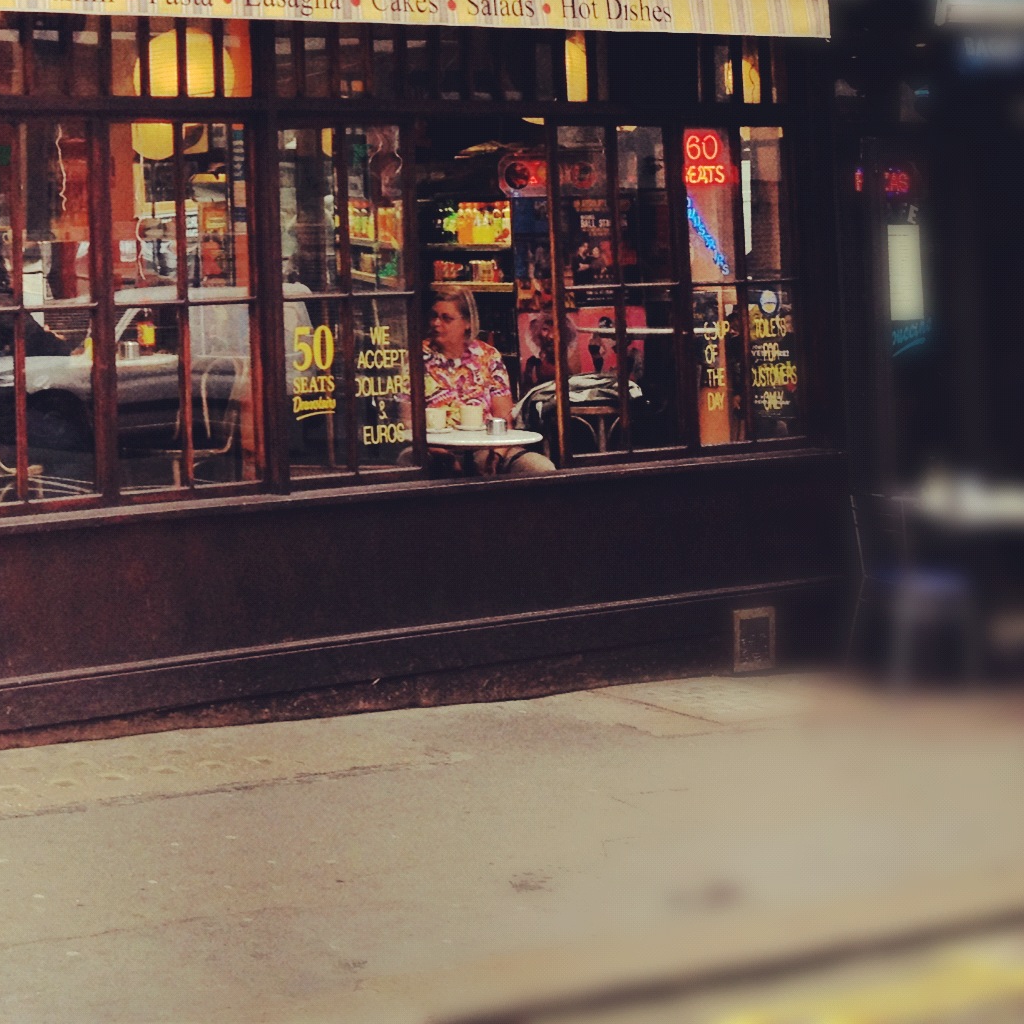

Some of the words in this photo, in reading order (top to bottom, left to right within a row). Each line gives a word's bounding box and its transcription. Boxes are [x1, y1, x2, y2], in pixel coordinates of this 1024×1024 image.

[686, 134, 718, 160] 60
[370, 325, 391, 346] WE
[292, 325, 335, 372] 50
[704, 343, 719, 365] OF
[357, 349, 407, 370] ACCEPT
[293, 376, 336, 394] SEATS
[706, 368, 726, 387] THE
[378, 401, 388, 420] &
[707, 392, 725, 411] DAY
[363, 423, 406, 445] EUROS
